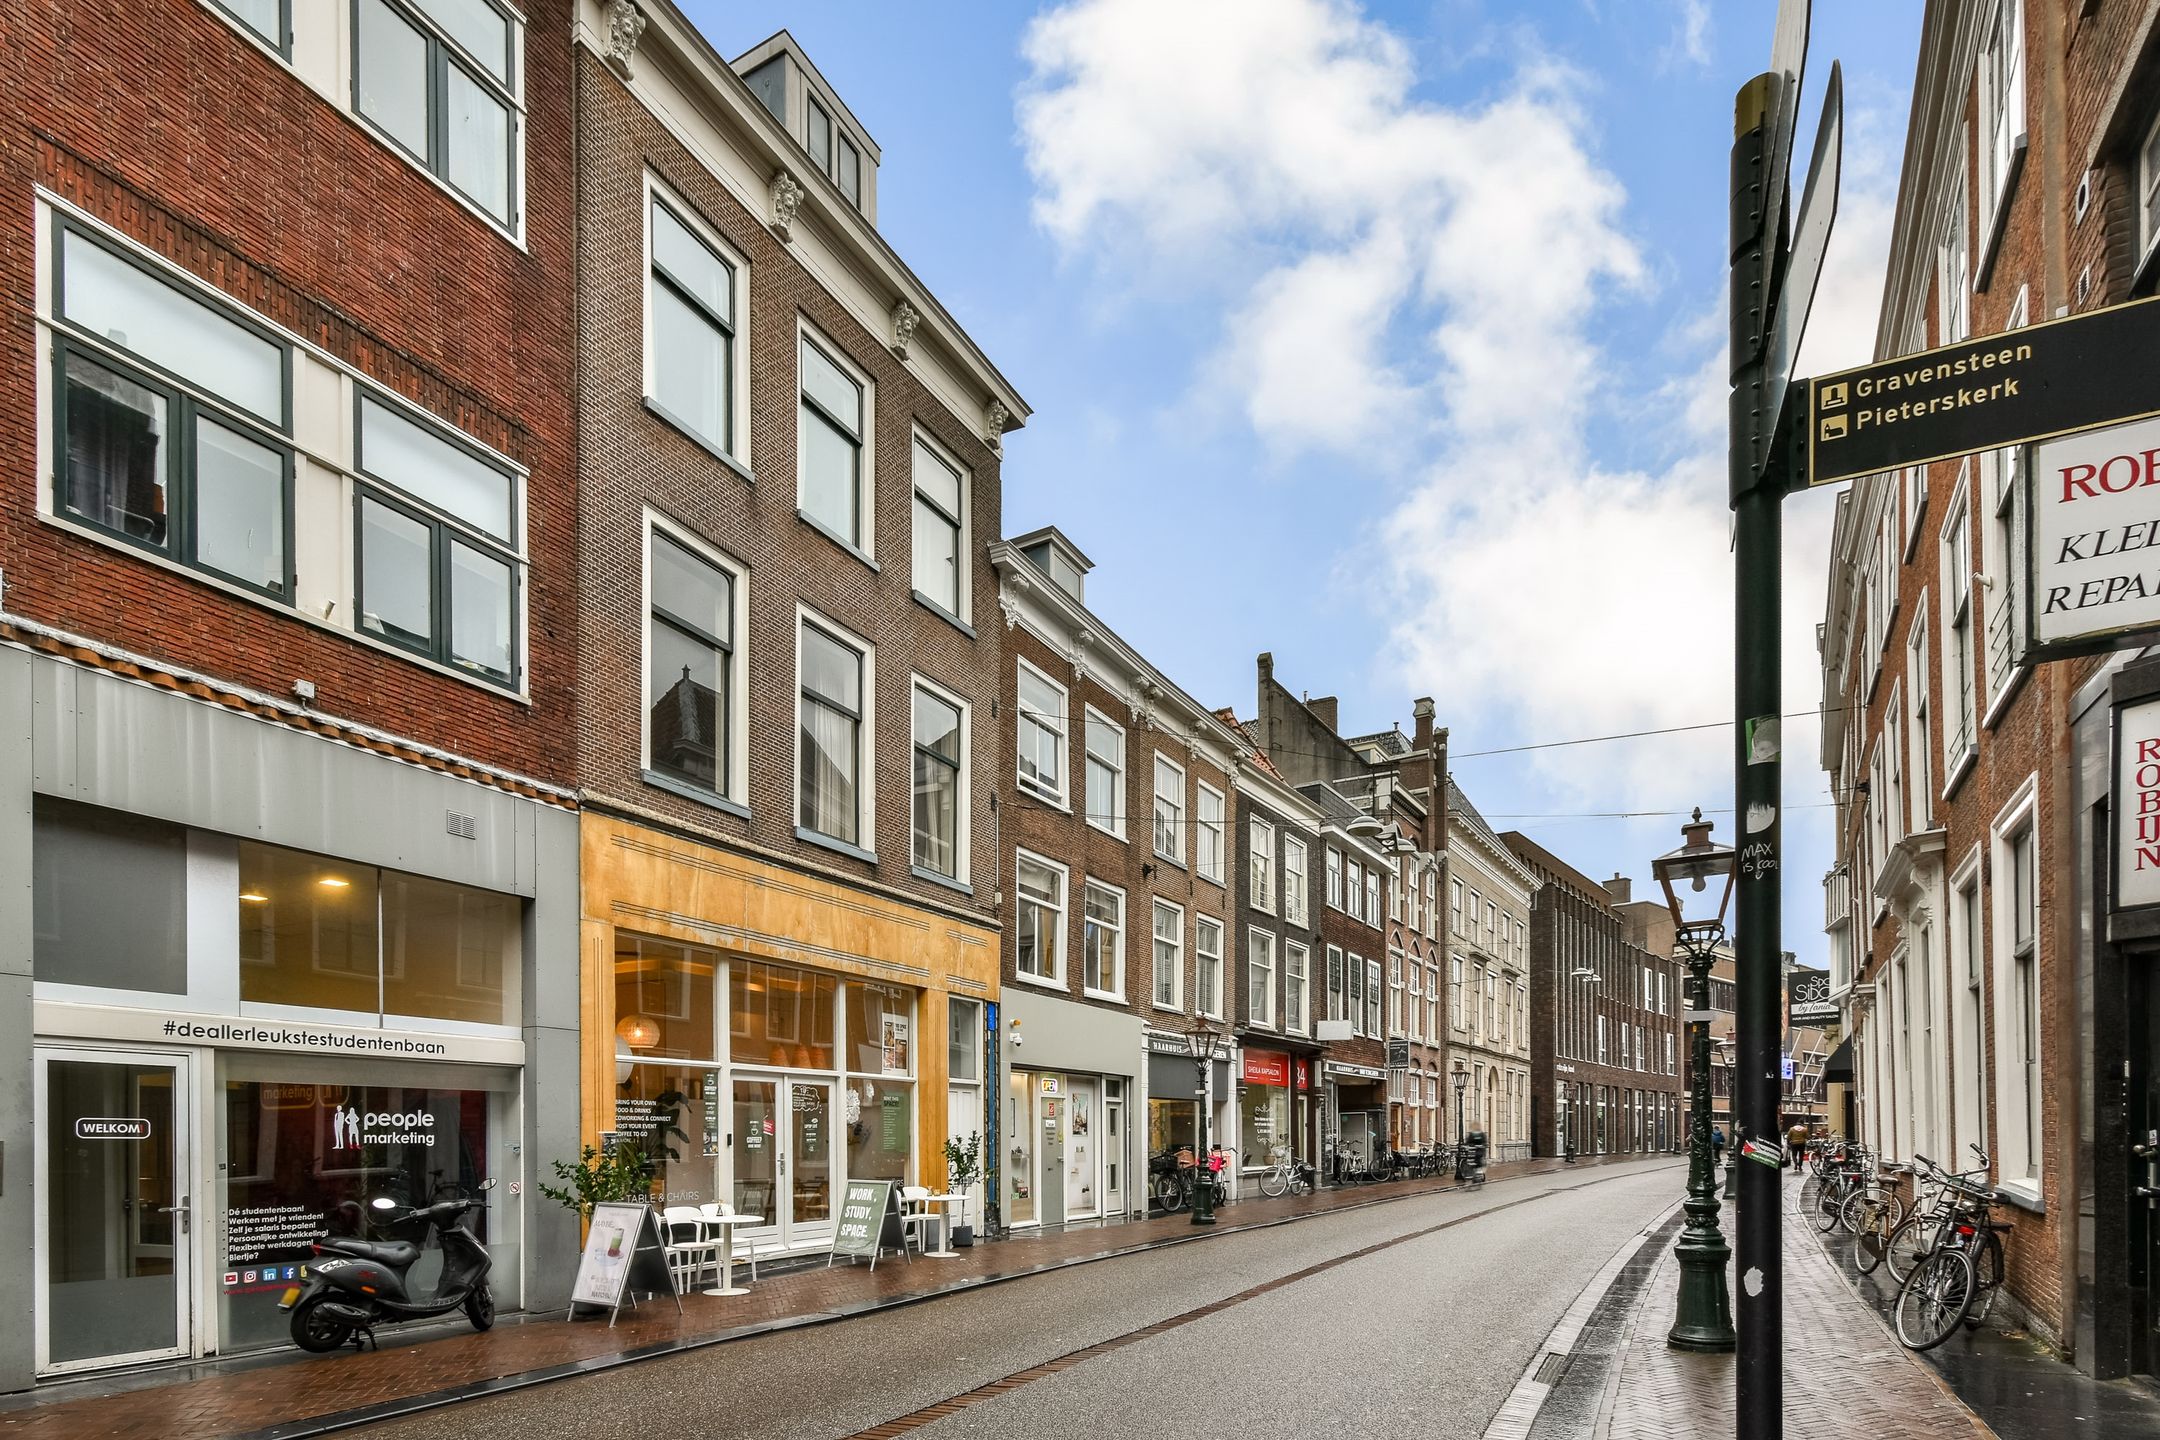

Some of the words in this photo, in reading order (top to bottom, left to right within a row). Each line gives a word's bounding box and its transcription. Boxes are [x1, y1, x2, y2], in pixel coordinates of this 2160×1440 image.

[1856, 344, 2032, 398] Gravensteen
[1856, 377, 2020, 430] Pieterskerk
[1741, 842, 1772, 862] MAX
[1799, 1003, 1807, 1014] by
[163, 1020, 445, 1054] #deallerleukstestudentenbaan
[1153, 1041, 1182, 1053] HAARHUIS
[1261, 1067, 1279, 1076] KAPSALON
[263, 1085, 312, 1100] marketing
[363, 1110, 435, 1131] people
[83, 1123, 144, 1134] WELKOM!
[363, 1132, 435, 1146] marketing
[626, 1193, 656, 1203] TABLE
[658, 1192, 665, 1202] &
[667, 1191, 700, 1202] CHAIRS
[229, 1208, 240, 1216] Dé
[242, 1205, 305, 1215] studentenbaan!
[844, 1205, 872, 1221] STUDY,
[229, 1217, 260, 1225] Werken
[261, 1215, 277, 1223] met
[279, 1214, 286, 1223] je
[288, 1213, 324, 1221] vrienden!
[229, 1225, 243, 1234] Zelf
[244, 1225, 253, 1234] je
[254, 1223, 280, 1232] salaris
[281, 1221, 316, 1231] bepalen!
[841, 1223, 868, 1238] SPACE.
[229, 1234, 277, 1243] Persoonlijke
[279, 1229, 329, 1239] ontwikkeling!
[229, 1242, 265, 1252] Flexibele
[267, 1239, 314, 1249] werkdagen!
[229, 1252, 259, 1261] Biertje?
